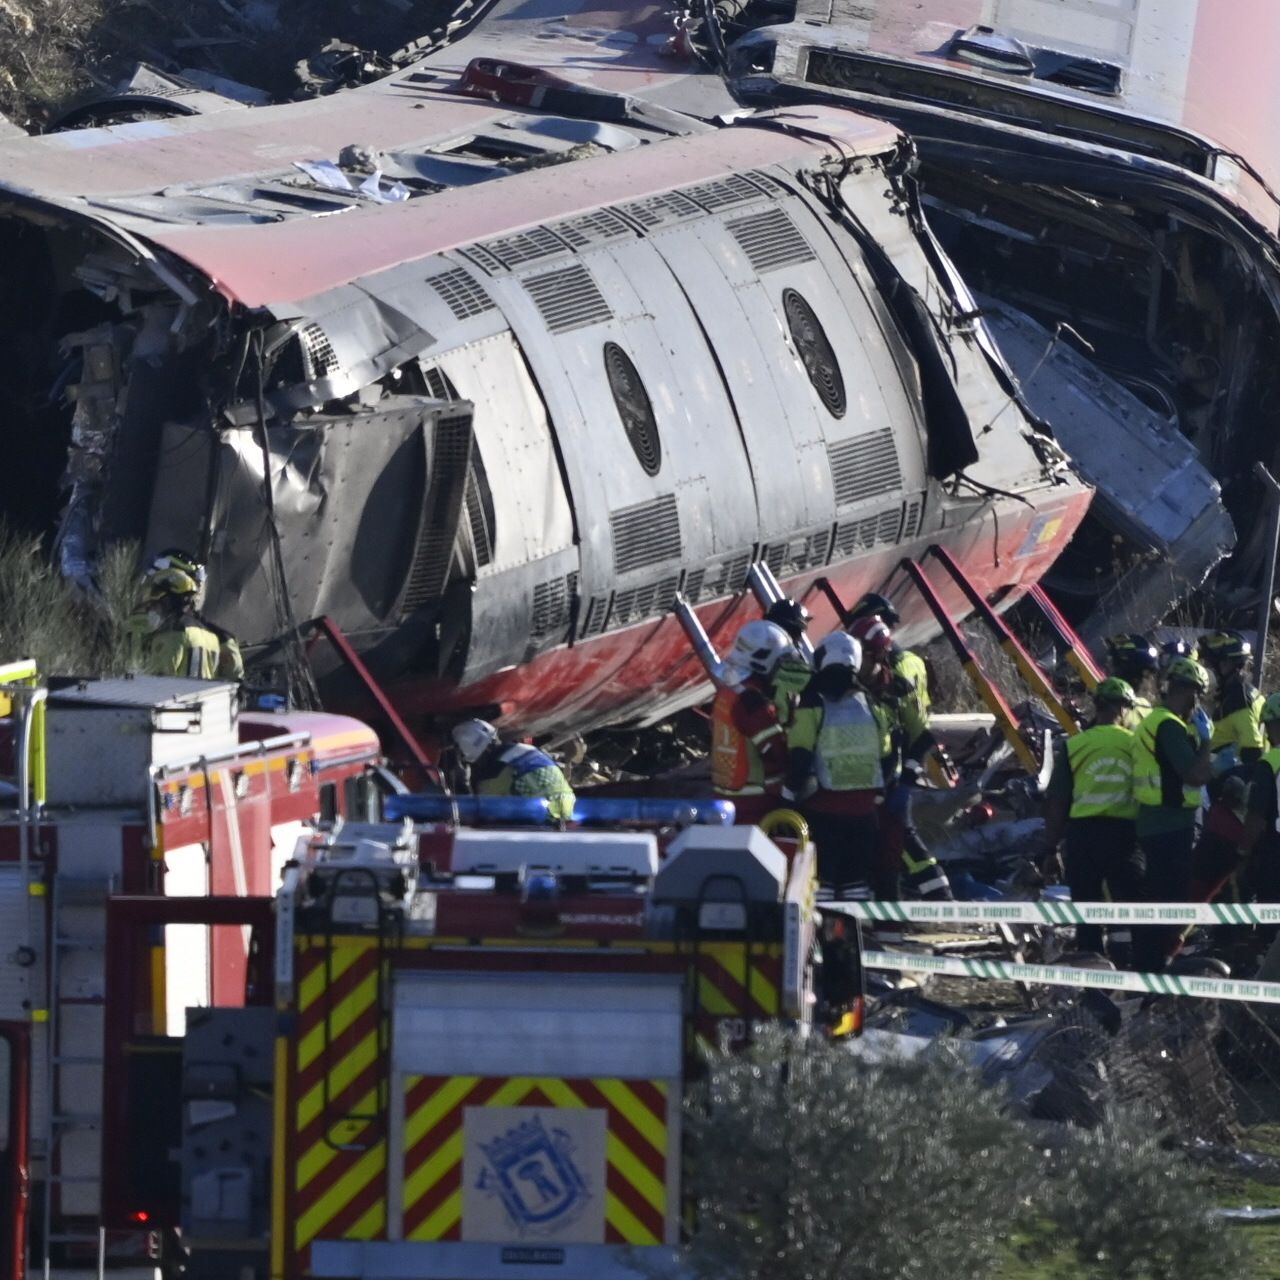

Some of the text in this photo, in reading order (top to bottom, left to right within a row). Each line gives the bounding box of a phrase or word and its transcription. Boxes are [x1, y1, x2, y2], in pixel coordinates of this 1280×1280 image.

[909, 906, 1022, 920] GUARDIA CIVIL NO PASAR
[1085, 907, 1197, 920] GUARDIA CIVIL NO PASAR
[1188, 980, 1218, 994] PASAR
[1221, 984, 1234, 995] NO
[1238, 985, 1260, 998] CIVIL
